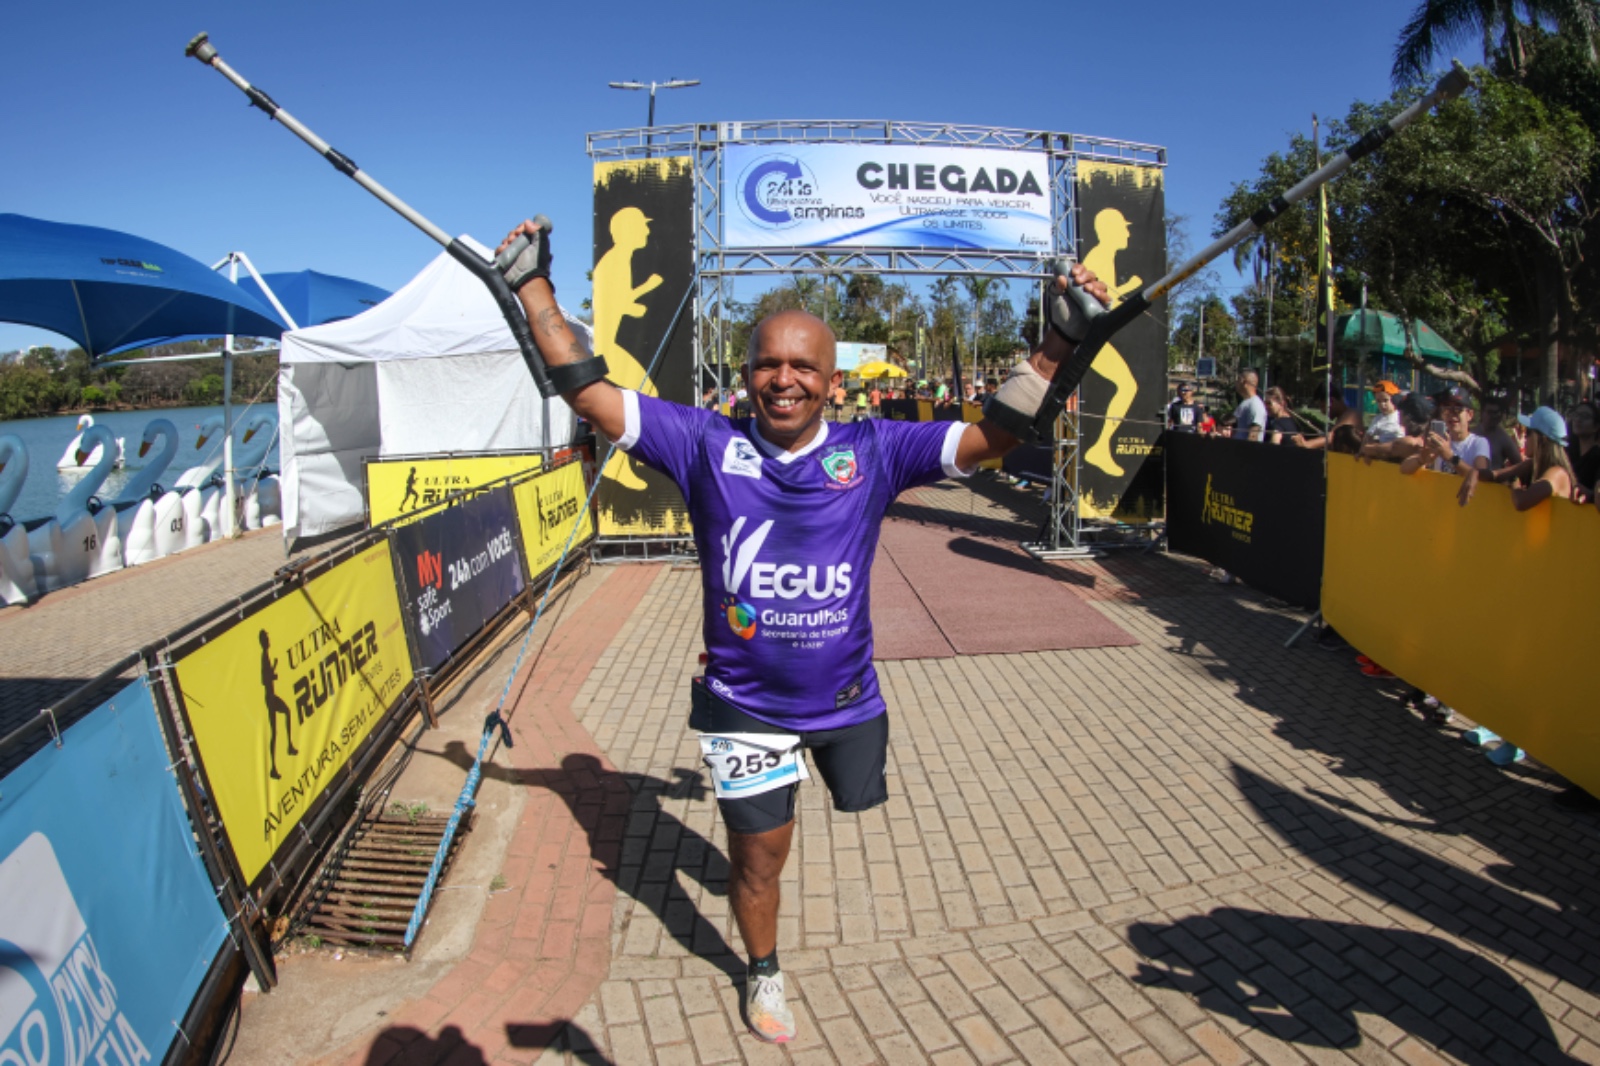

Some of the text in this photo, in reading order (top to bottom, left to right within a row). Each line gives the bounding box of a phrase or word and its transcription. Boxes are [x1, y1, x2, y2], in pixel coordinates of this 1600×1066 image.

[857, 161, 1043, 197] CHEGADA
[869, 191, 902, 204] VOCÊ
[906, 195, 951, 205] NASCEU
[955, 196, 984, 206] PARA
[922, 218, 939, 229] OS
[972, 208, 1009, 219] TODOS
[424, 475, 471, 486] ULTRA
[1209, 502, 1254, 533] RUNNER
[83, 534, 97, 552] 16
[417, 549, 443, 590] My
[448, 556, 471, 590] 24h
[470, 550, 490, 577] com
[720, 516, 852, 600] VEGUS
[761, 607, 848, 628] Guarulhos
[286, 616, 342, 670] ULTRA
[761, 628, 808, 639] Secretaria
[809, 629, 820, 639] de
[801, 640, 825, 649] Lazer
[293, 620, 378, 725] RUNNER
[264, 740, 342, 840] AVENTURA
[340, 713, 367, 746] SEM
